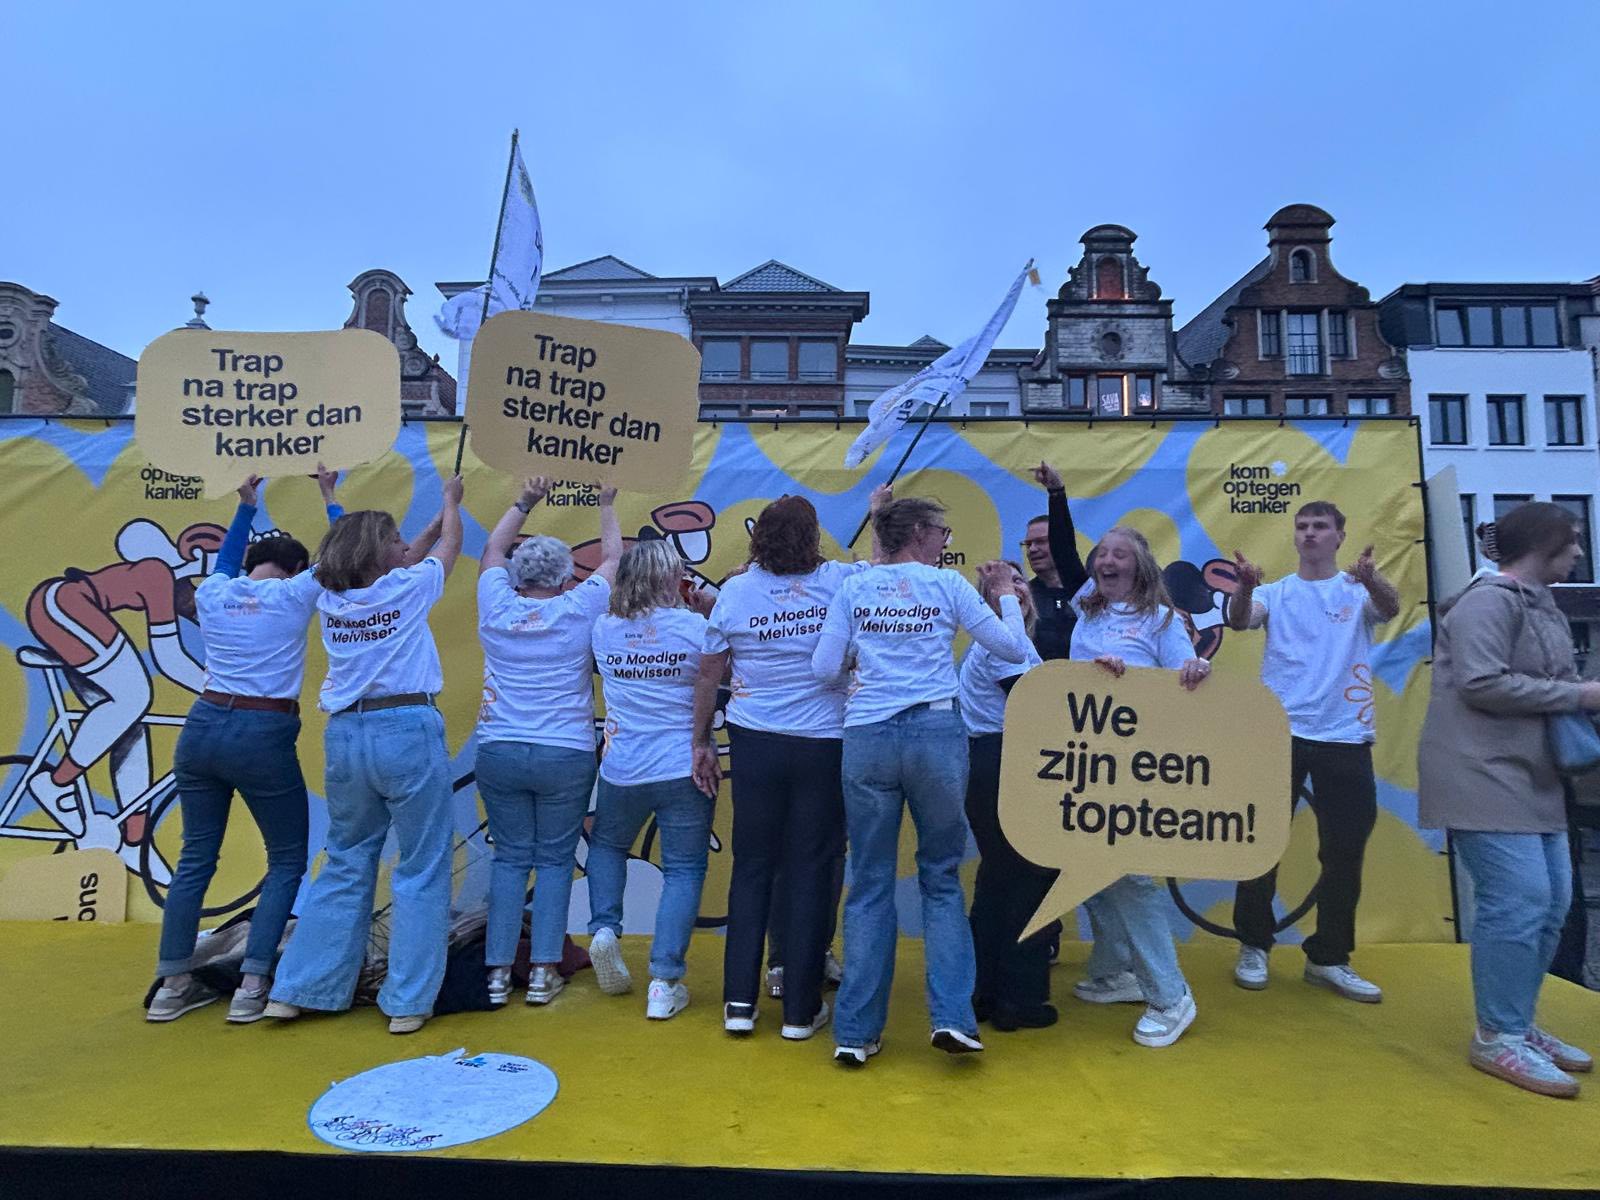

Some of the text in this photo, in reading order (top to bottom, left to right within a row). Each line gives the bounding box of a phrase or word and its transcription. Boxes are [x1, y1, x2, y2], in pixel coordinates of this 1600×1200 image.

[211, 348, 284, 378] Trap
[533, 334, 597, 373] Trap
[183, 377, 298, 406] na trap
[506, 365, 606, 407] na trap
[182, 403, 362, 427] sterker dan
[502, 395, 661, 443] sterker dan
[215, 432, 325, 457] kanker
[527, 426, 624, 466] kanker
[140, 467, 162, 484] op
[1230, 463, 1270, 479] kom
[144, 483, 202, 500] kanker
[1223, 480, 1301, 500] op tegen
[1230, 497, 1291, 514] kanker
[749, 605, 828, 628] De Moedig
[853, 604, 941, 620] De Moedige
[606, 650, 688, 666] De Moedige
[1067, 692, 1138, 737] We
[1037, 740, 1210, 794] zijn een
[1059, 792, 1256, 846] topteam!
